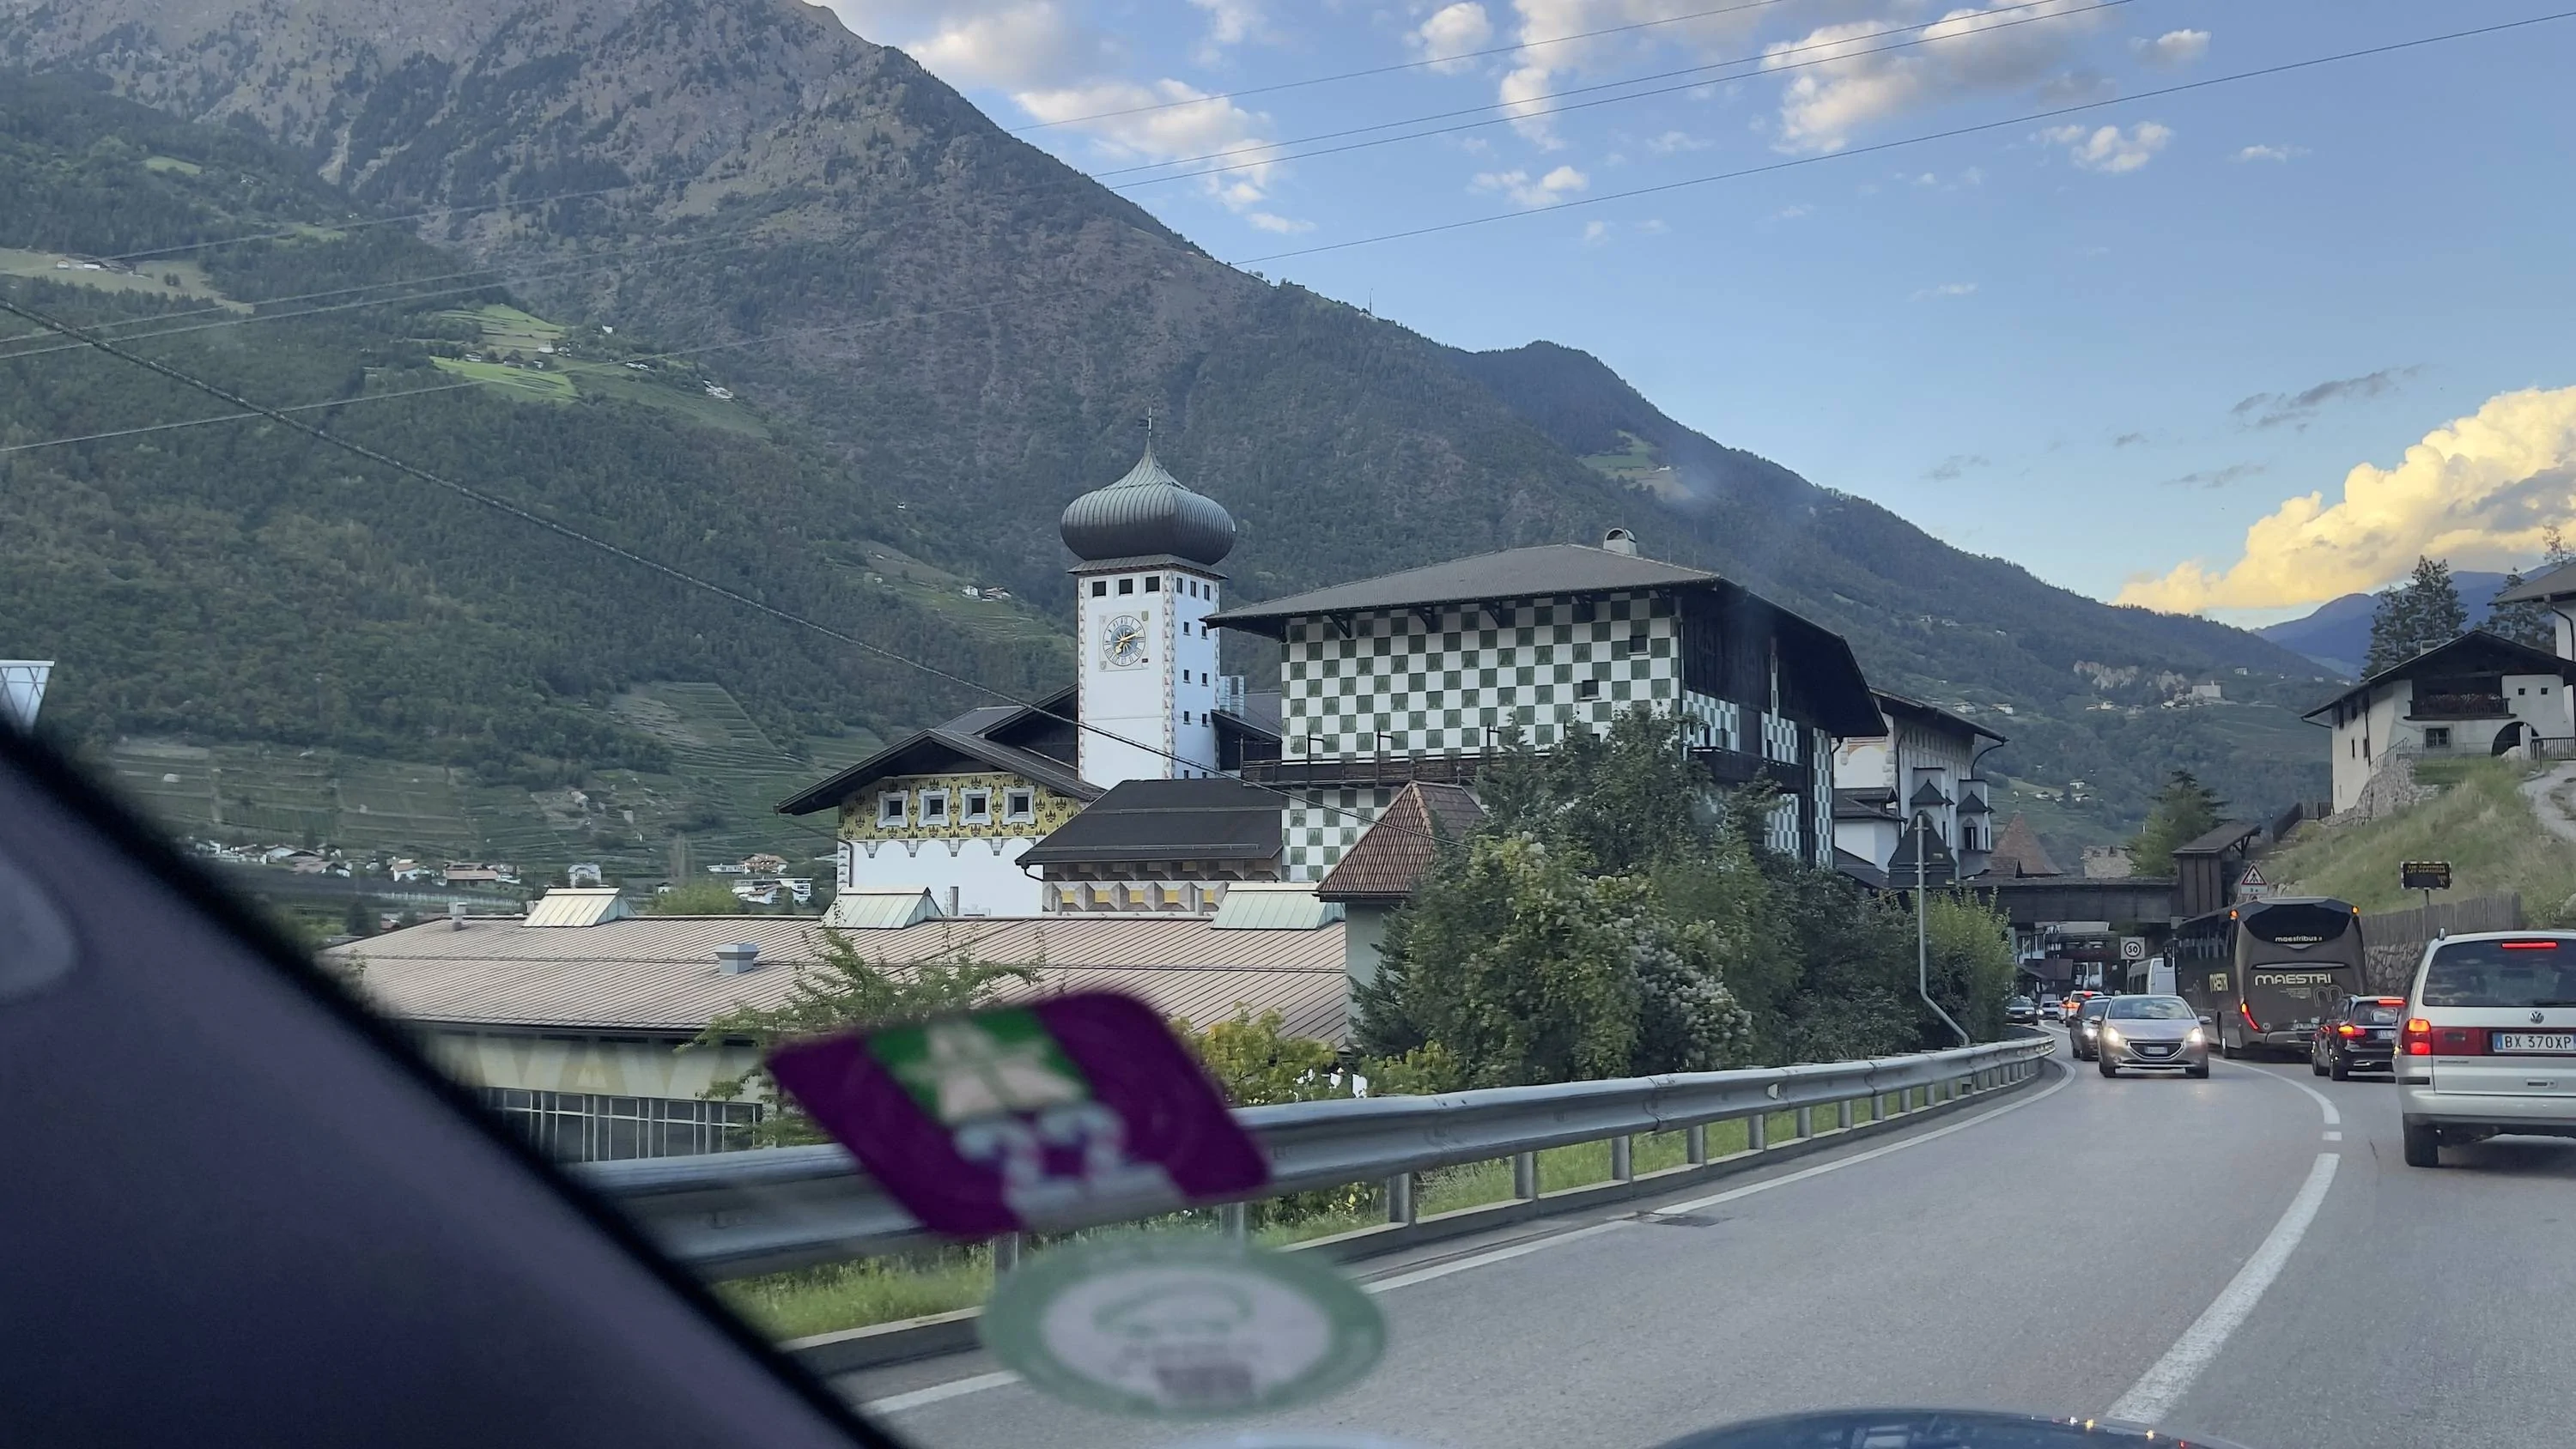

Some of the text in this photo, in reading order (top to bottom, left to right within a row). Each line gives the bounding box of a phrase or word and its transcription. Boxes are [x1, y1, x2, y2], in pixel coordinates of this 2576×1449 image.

[2128, 945, 2138, 954] 50
[2255, 973, 2332, 986] MAESTRI
[2505, 1035, 2522, 1048] BX
[2527, 1035, 2572, 1049] 370XP
